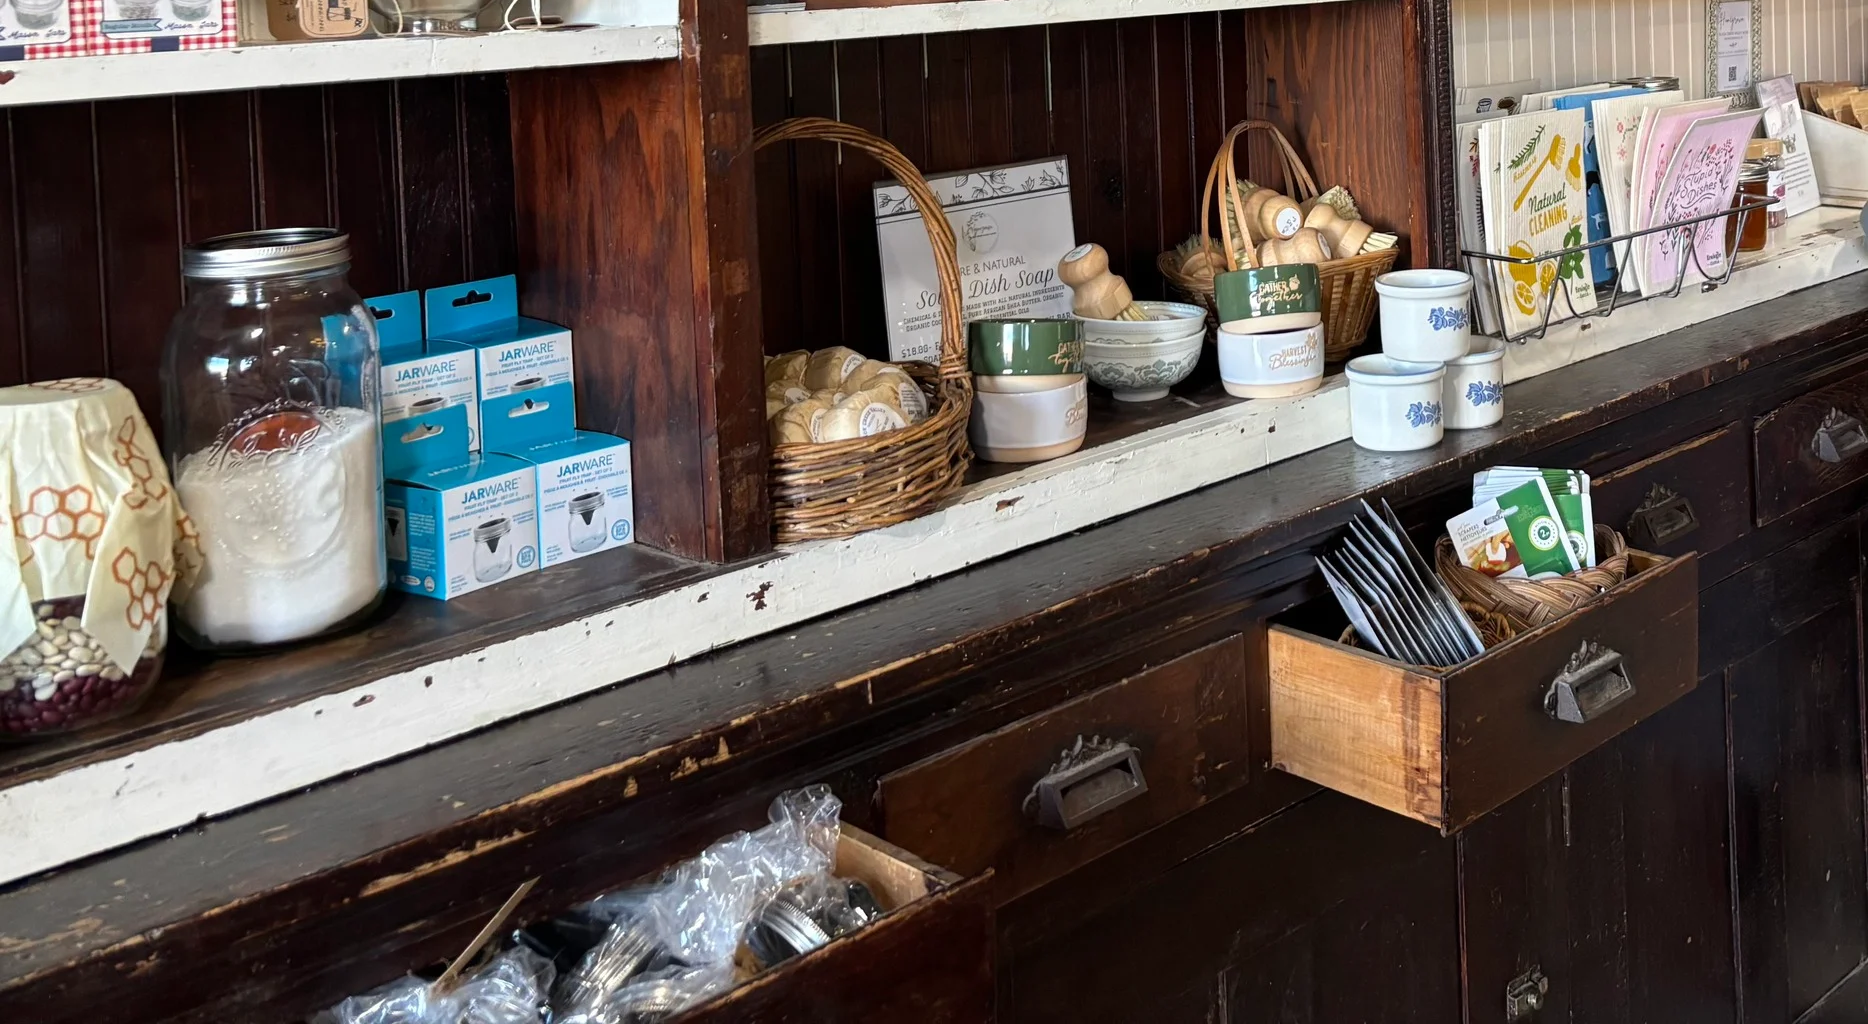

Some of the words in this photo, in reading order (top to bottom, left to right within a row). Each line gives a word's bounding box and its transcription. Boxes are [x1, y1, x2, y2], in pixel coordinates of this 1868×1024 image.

[164, 22, 194, 30] Mason
[1528, 182, 1567, 215] Natural
[1528, 204, 1569, 237] CLEANING
[973, 264, 982, 275] &
[982, 255, 1027, 273] NATURAL
[968, 272, 1012, 300] Dish
[1014, 267, 1054, 289] Soap
[1258, 281, 1288, 296] GATHER
[966, 302, 982, 312] MADE
[982, 300, 997, 309] WITH
[998, 297, 1008, 305] ALL
[1008, 292, 1032, 302] NATURAL
[1032, 284, 1065, 297] INGREDIENTS
[968, 310, 982, 319] PURE
[1006, 302, 1020, 311] SHEA
[1042, 291, 1064, 302] ORGANIC
[1250, 291, 1304, 312] together
[903, 313, 933, 325] CHEMICAL
[905, 320, 931, 332] ORGANIC
[498, 340, 555, 363] JARWARE
[1281, 345, 1307, 360] HARVEST
[395, 359, 457, 383] JARWARE
[557, 453, 614, 479] JARWARE
[461, 478, 520, 505] JARWARE
[1457, 523, 1480, 538] SCRAPERS
